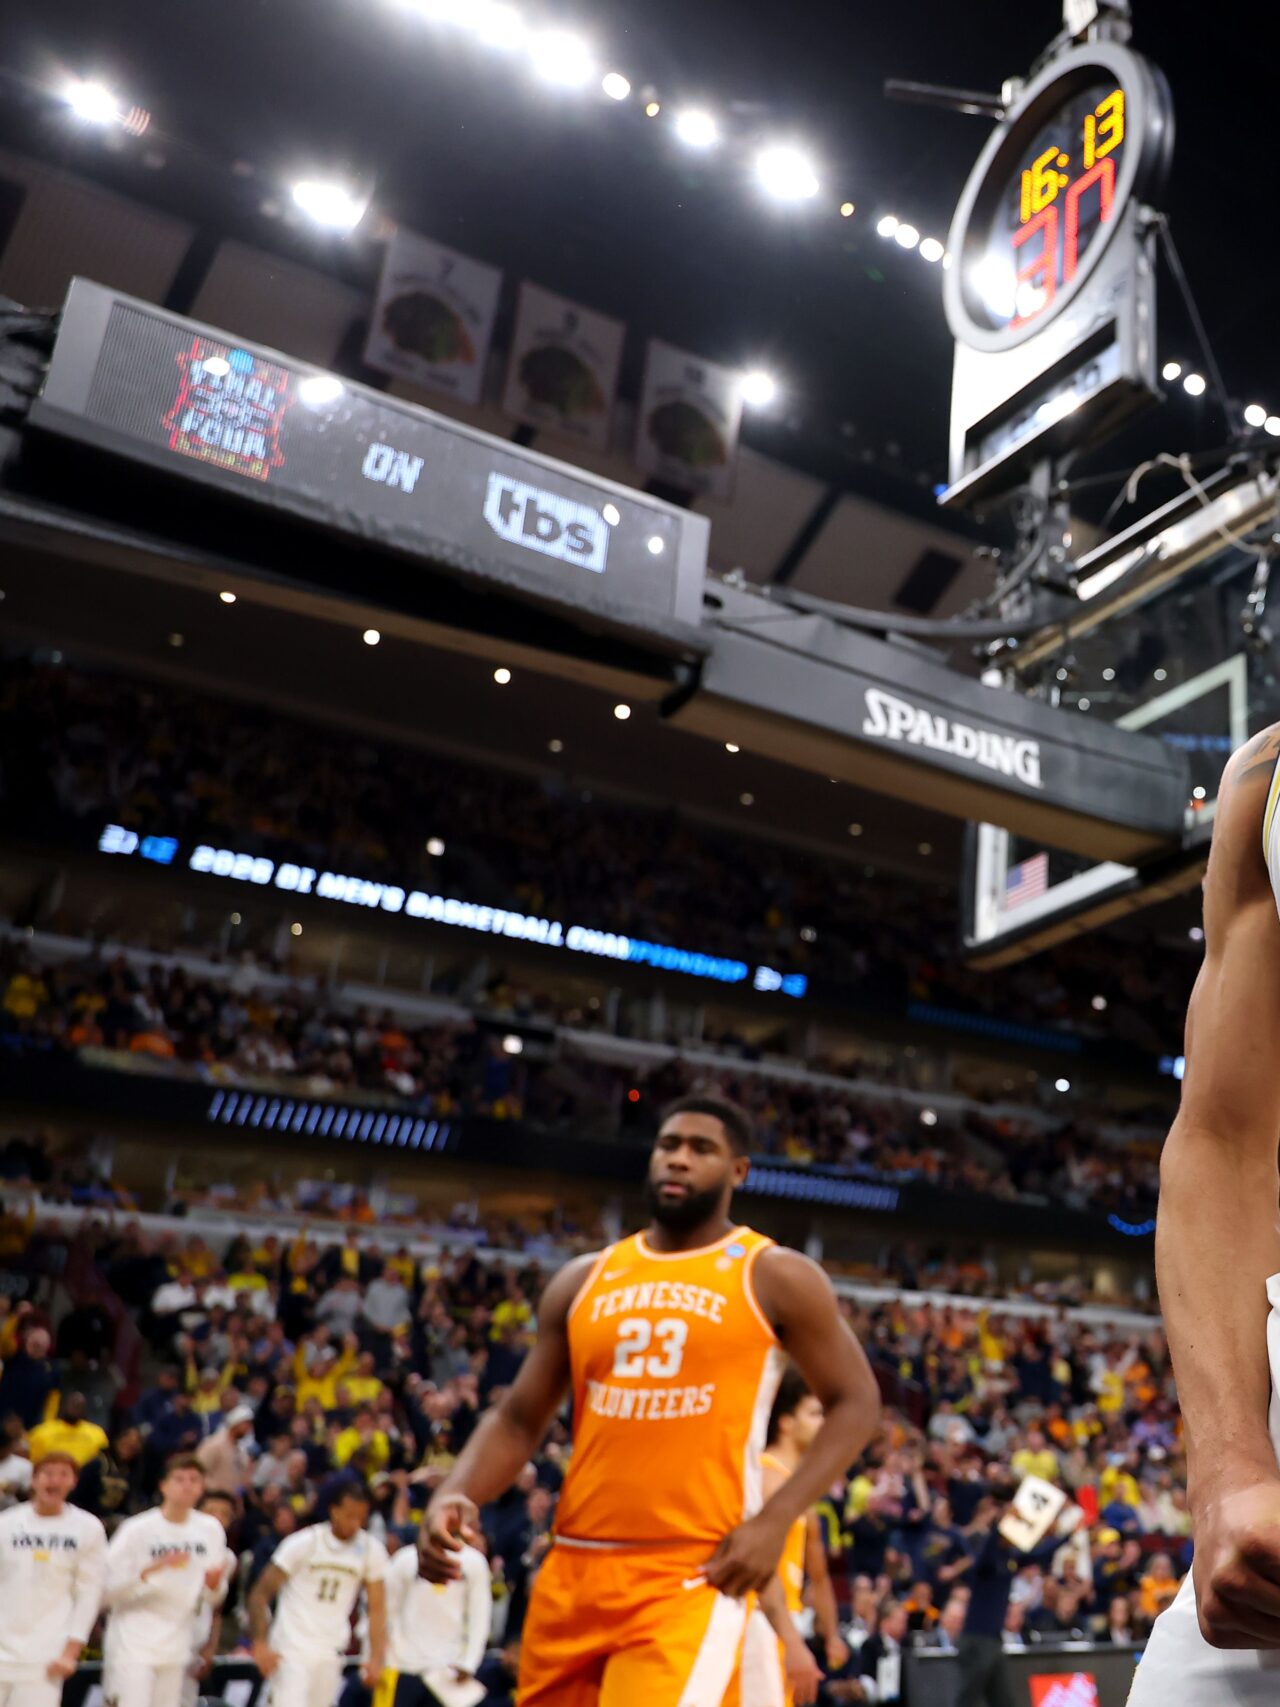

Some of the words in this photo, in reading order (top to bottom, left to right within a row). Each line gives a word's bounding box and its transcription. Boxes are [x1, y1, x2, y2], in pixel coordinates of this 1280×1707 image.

[1019, 88, 1125, 224] 16:13
[361, 441, 425, 494] ON
[498, 486, 597, 556] tbs
[862, 687, 1046, 790] SPALDING
[590, 1280, 728, 1325] TENNESSEE
[611, 1317, 689, 1379] 23
